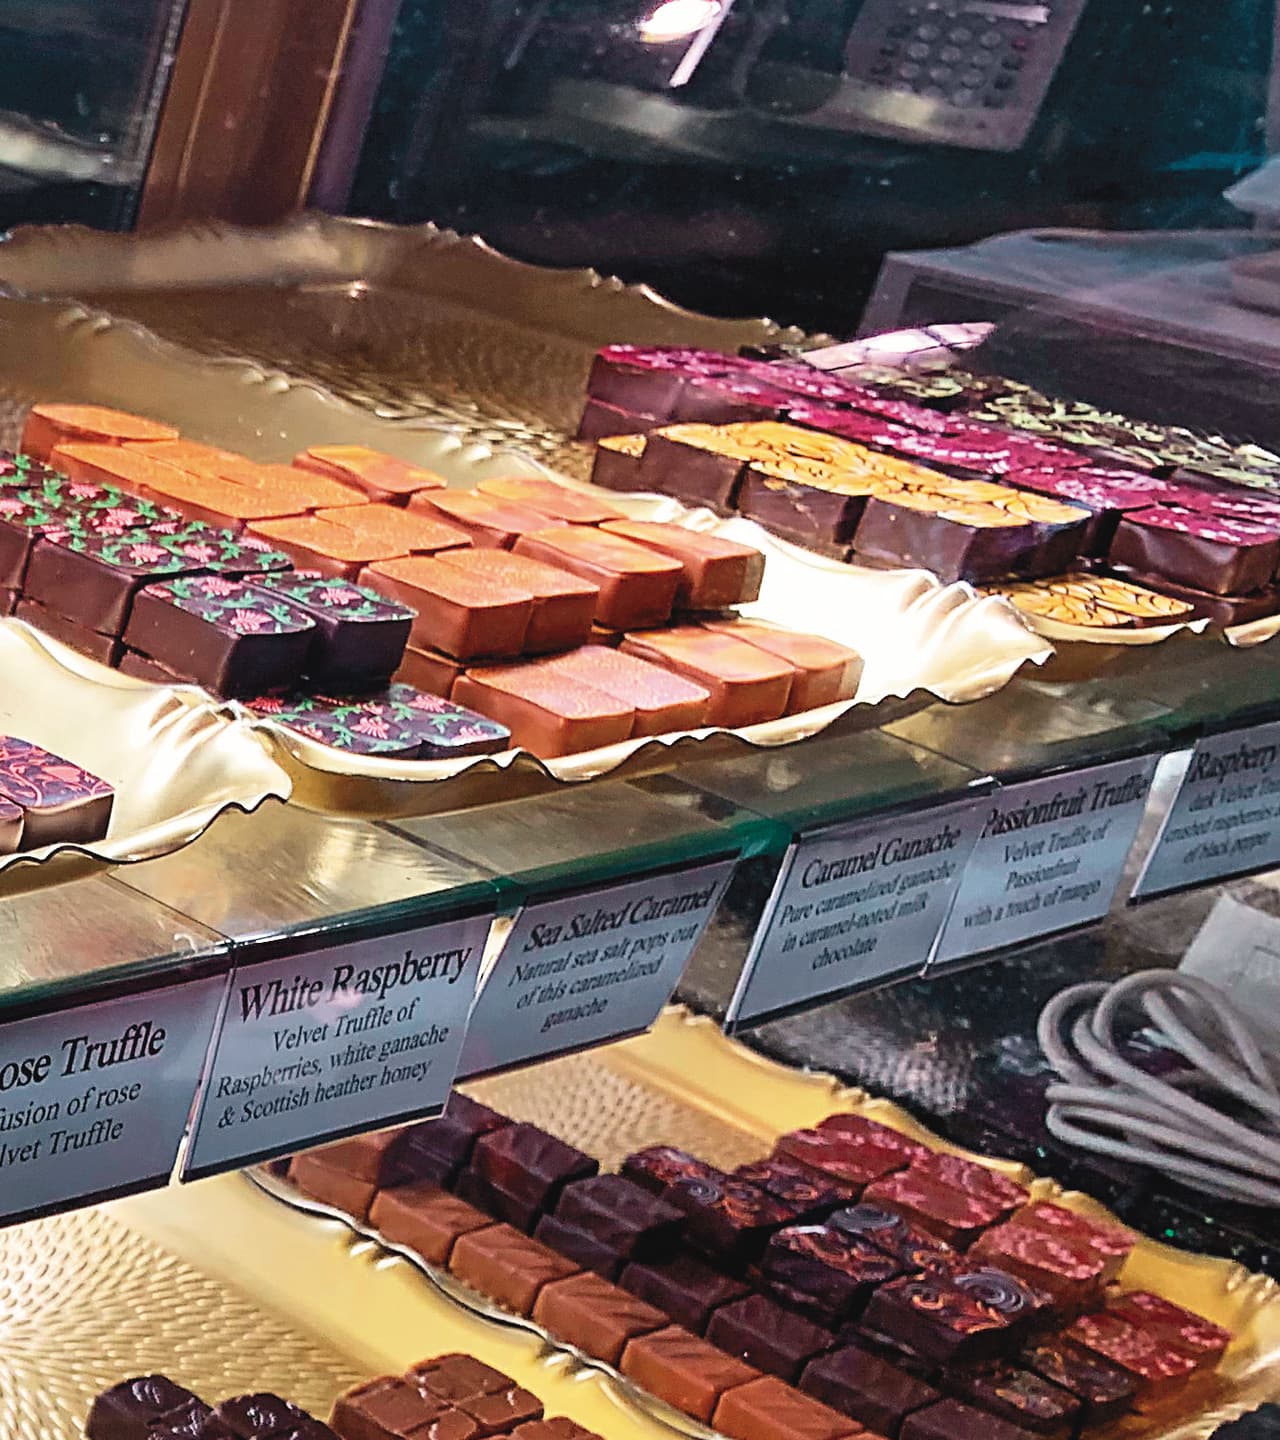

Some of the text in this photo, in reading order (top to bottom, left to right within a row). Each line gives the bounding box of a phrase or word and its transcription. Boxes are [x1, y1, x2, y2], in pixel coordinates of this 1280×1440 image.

[802, 842, 881, 888] Caramel
[881, 825, 961, 865] Ganache
[524, 922, 562, 952] Sea
[564, 902, 627, 942] Salted
[240, 947, 472, 1024] White Raspberry
[508, 950, 572, 988] Natural
[60, 1021, 166, 1077] Truffle
[273, 997, 420, 1052] Velvet Truffle of
[216, 1024, 450, 1098] Raspberries, white ganache
[66, 1088, 95, 1114] of
[95, 1082, 142, 1110] rose
[218, 1058, 433, 1128] & Scottish heather honey
[48, 1119, 124, 1156] Truffle
